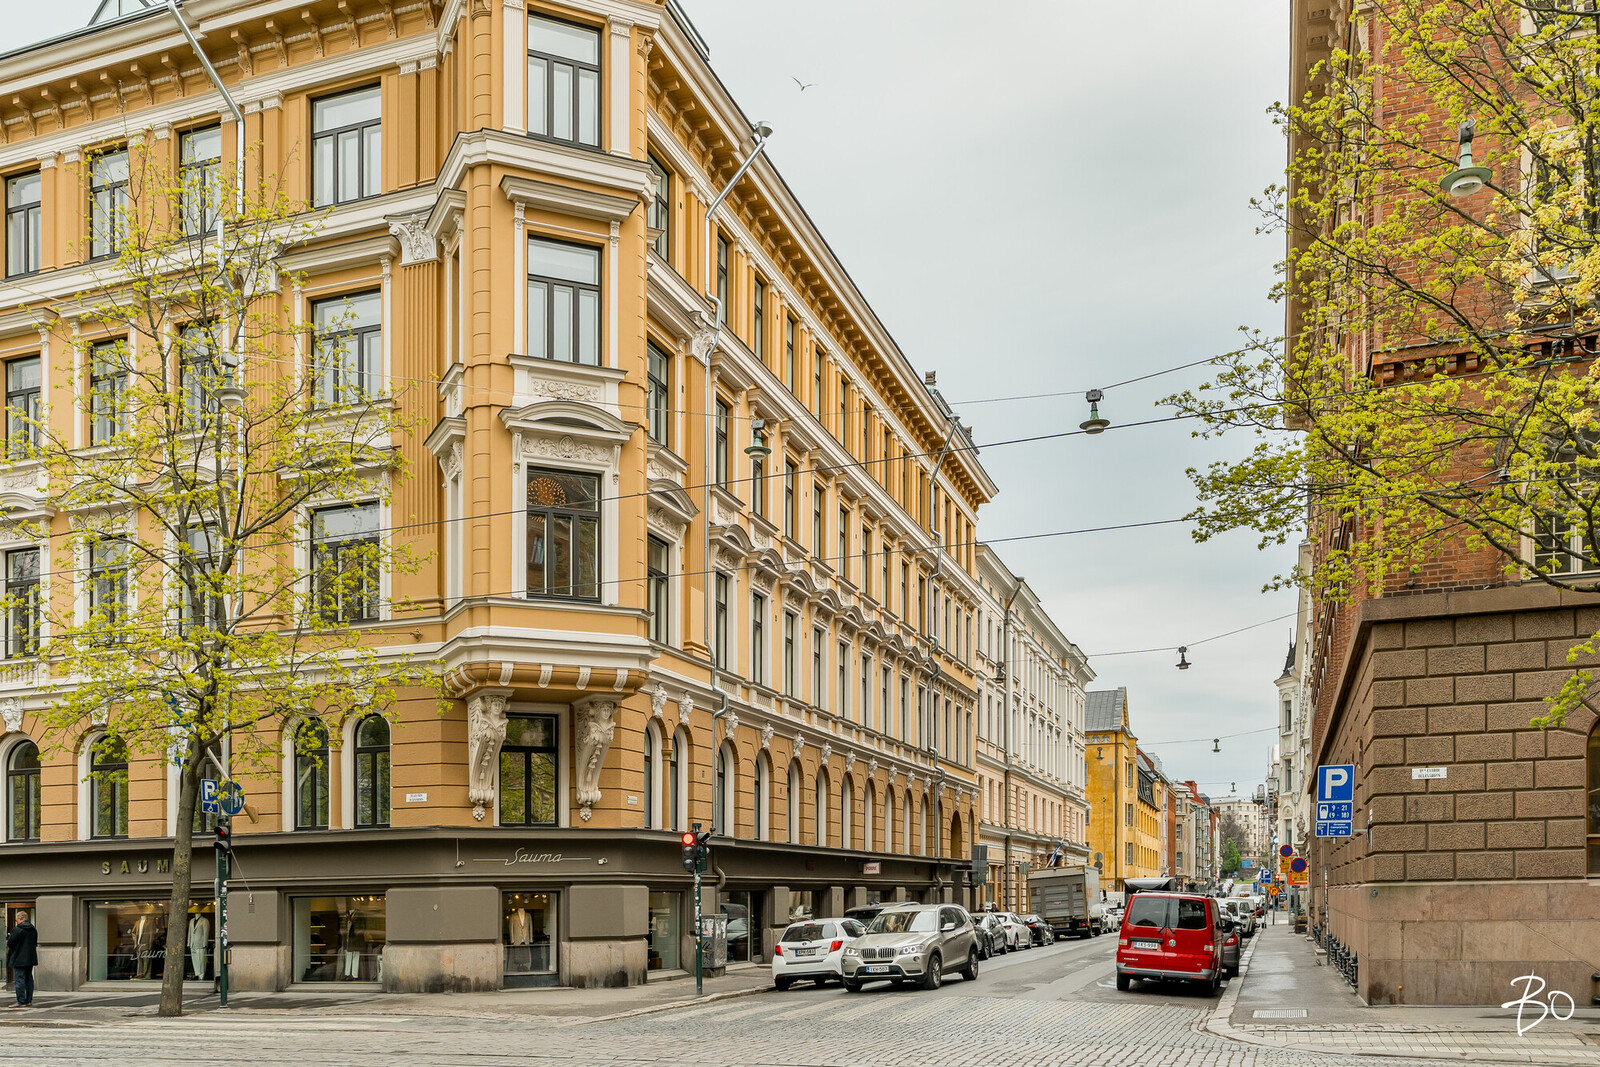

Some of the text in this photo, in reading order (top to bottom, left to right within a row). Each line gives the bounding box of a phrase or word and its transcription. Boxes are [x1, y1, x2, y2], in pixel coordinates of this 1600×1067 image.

[204, 781, 215, 800] P
[1325, 768, 1348, 799] P
[504, 847, 562, 866] Sauma
[101, 858, 168, 875] SAUM
[1262, 870, 1270, 878] P
[130, 943, 167, 961] Saum
